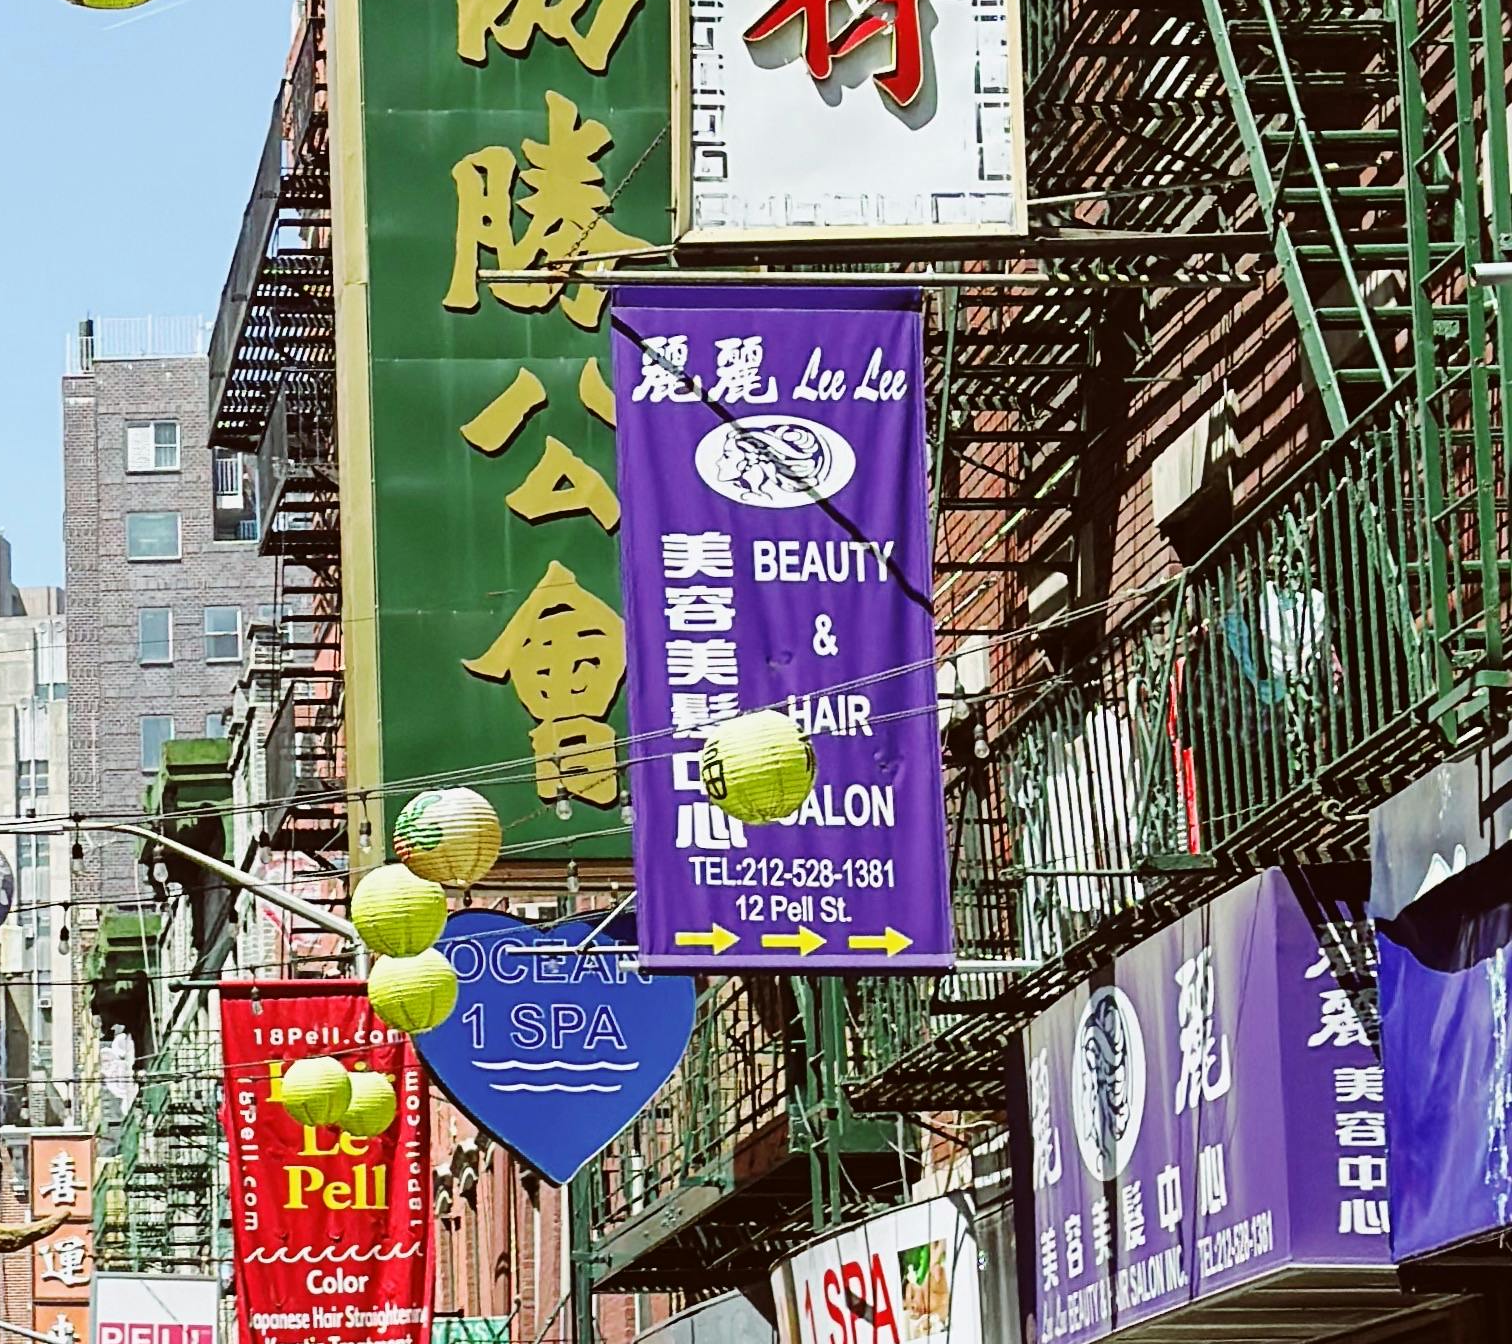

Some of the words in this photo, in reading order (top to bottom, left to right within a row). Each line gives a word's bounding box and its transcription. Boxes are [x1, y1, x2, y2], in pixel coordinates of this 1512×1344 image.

[631, 334, 779, 404] 麗麗
[752, 539, 895, 583] BEAUTY
[812, 612, 839, 657] &
[787, 693, 874, 737] HAIR
[780, 784, 896, 827] ALON
[688, 855, 896, 889] TEL:212-528-1381
[735, 894, 765, 921] 12
[771, 895, 814, 923] Pell
[820, 898, 853, 923] St.
[443, 936, 653, 986] OCEAN
[253, 1026, 405, 1046] 18Pell.com
[462, 1003, 485, 1050] 1
[510, 1002, 628, 1052] SPA
[283, 1164, 390, 1210] Pell
[305, 1267, 370, 1295] Color
[312, 1305, 345, 1330] Hair
